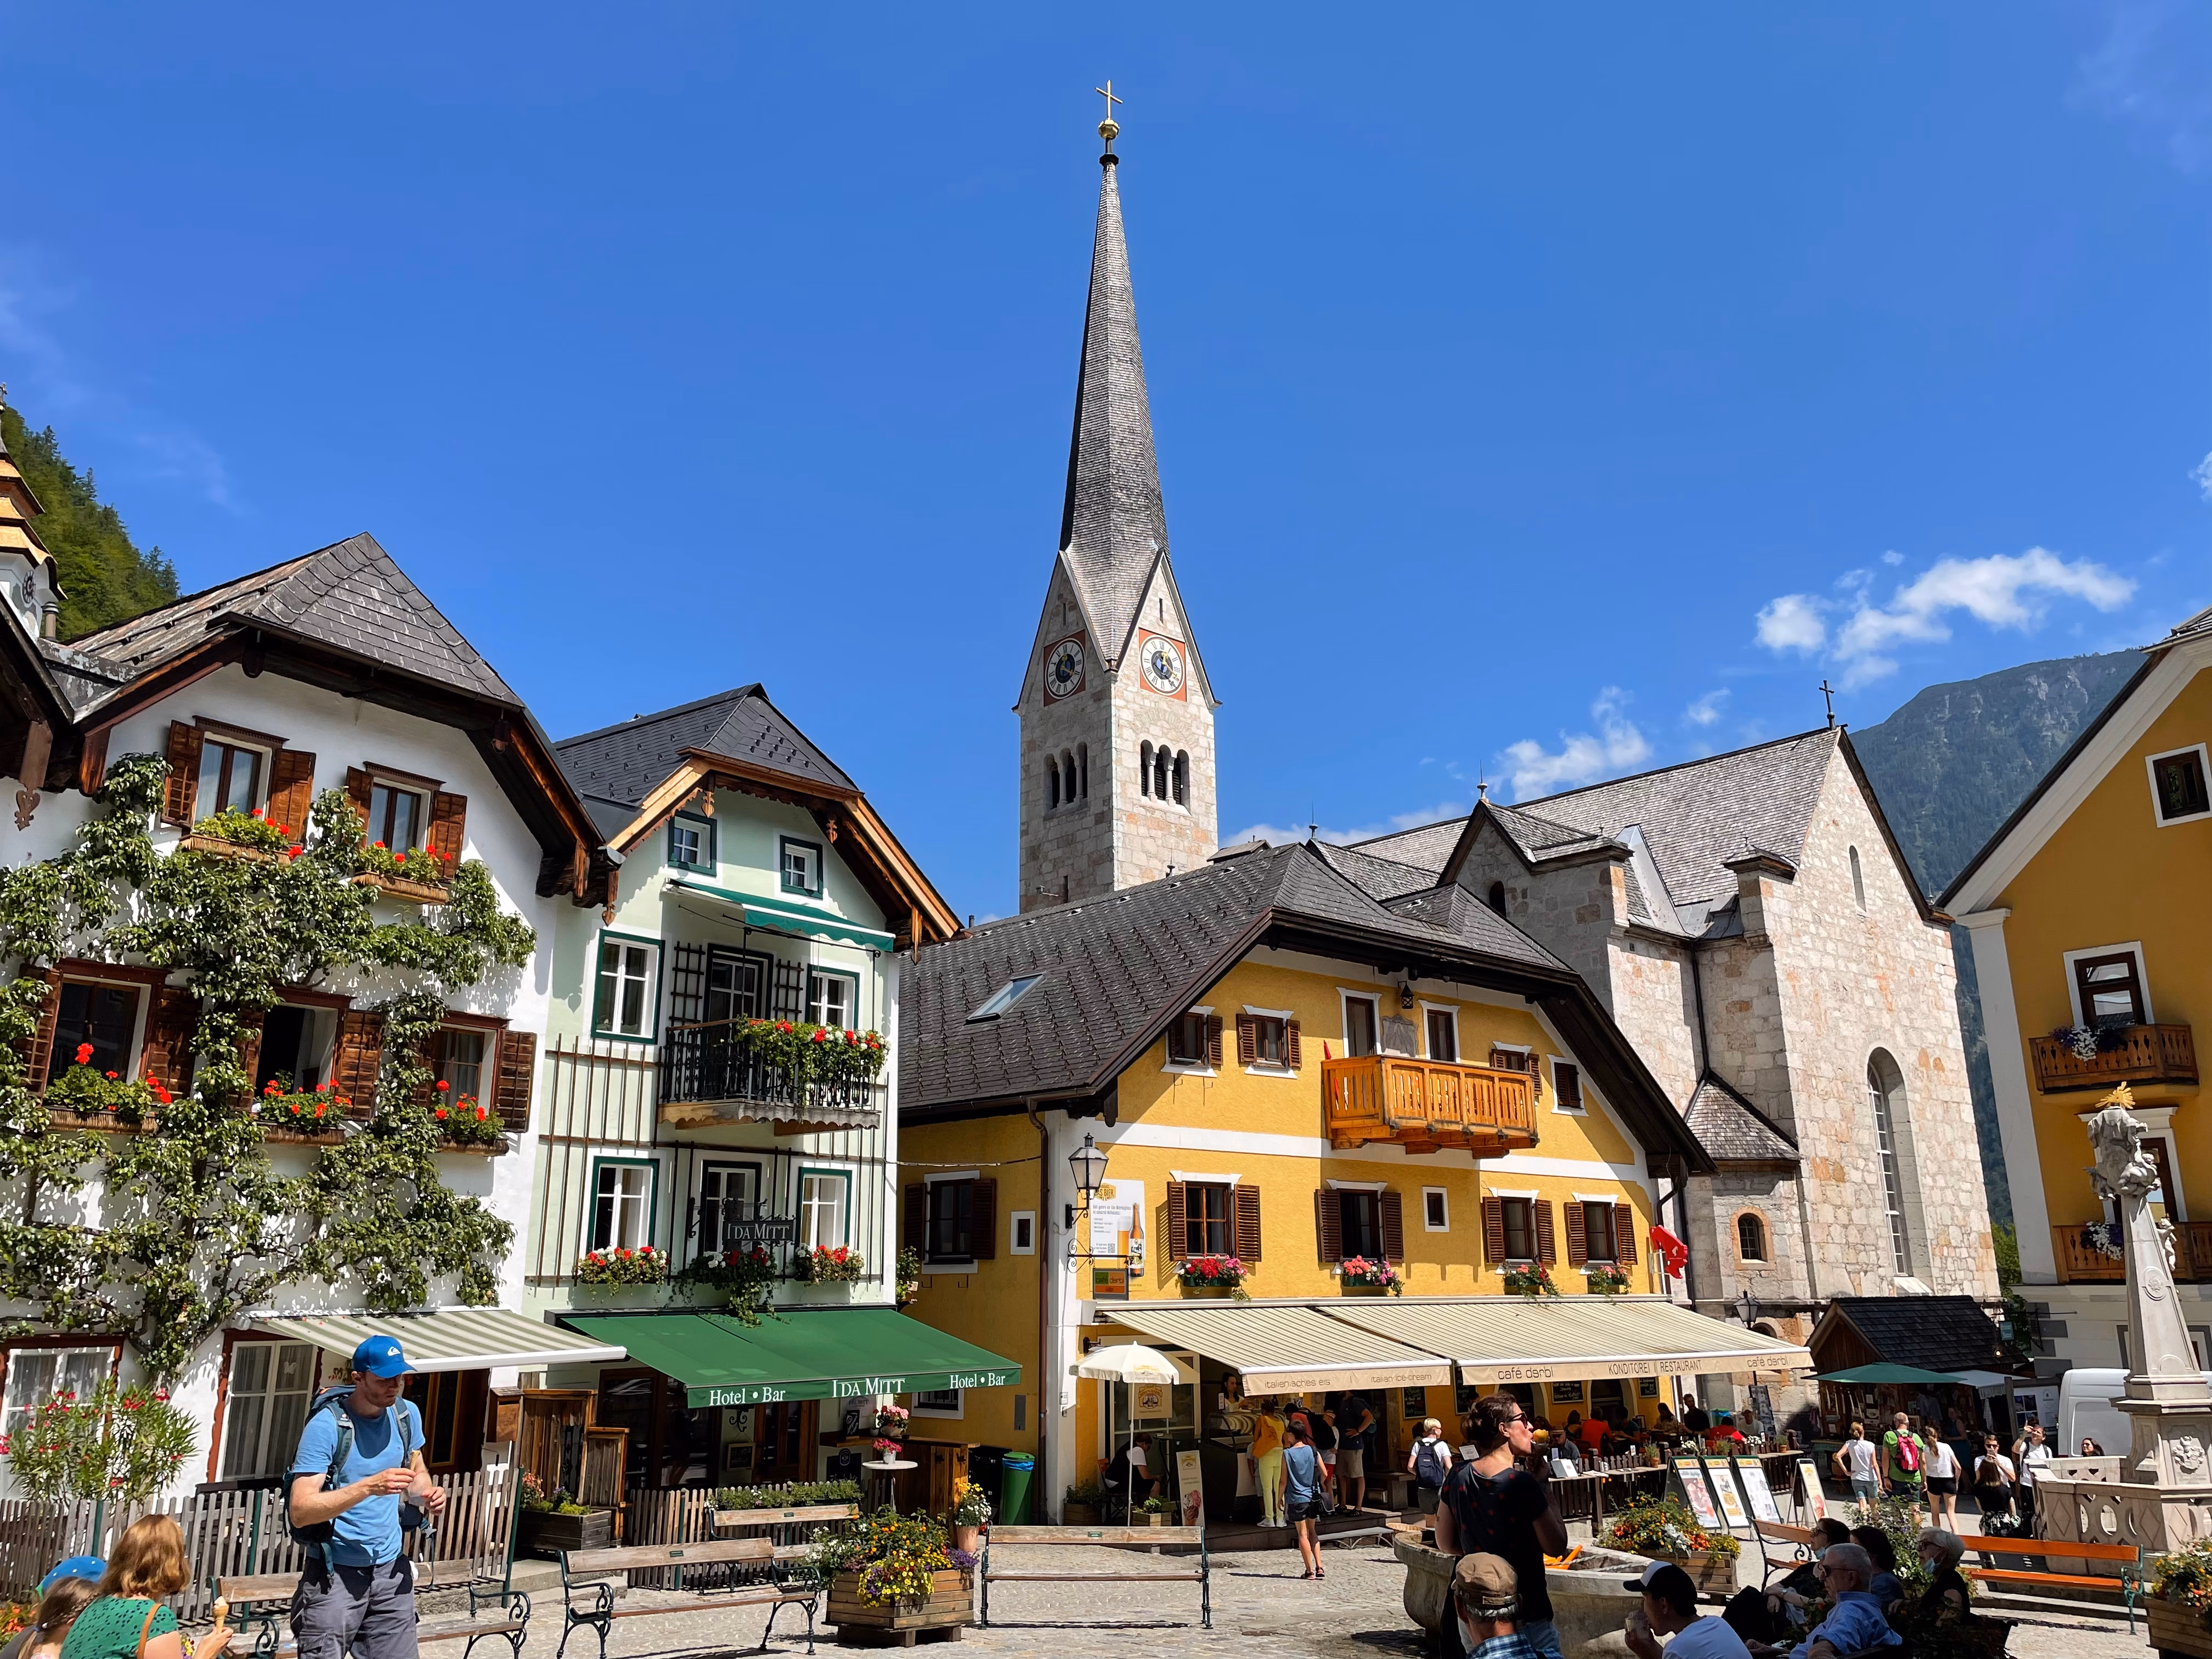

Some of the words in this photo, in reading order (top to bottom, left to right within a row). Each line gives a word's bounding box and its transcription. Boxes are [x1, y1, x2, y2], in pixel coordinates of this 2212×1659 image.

[727, 1223, 750, 1239] IDA
[754, 1223, 789, 1239] MITT
[1608, 1362, 1650, 1375] KONDITOREI
[1660, 1359, 1701, 1372] RESTAURANT
[1747, 1356, 1765, 1367] café
[950, 1373, 977, 1389] Hotel
[988, 1373, 1005, 1386] Bar
[1372, 1375, 1392, 1383] italian
[1498, 1367, 1522, 1379] café
[832, 1379, 861, 1398] IDA
[865, 1378, 906, 1395] MITT
[1265, 1379, 1316, 1389] italienisches
[709, 1387, 746, 1406] Hotel
[762, 1387, 786, 1402] Bar
